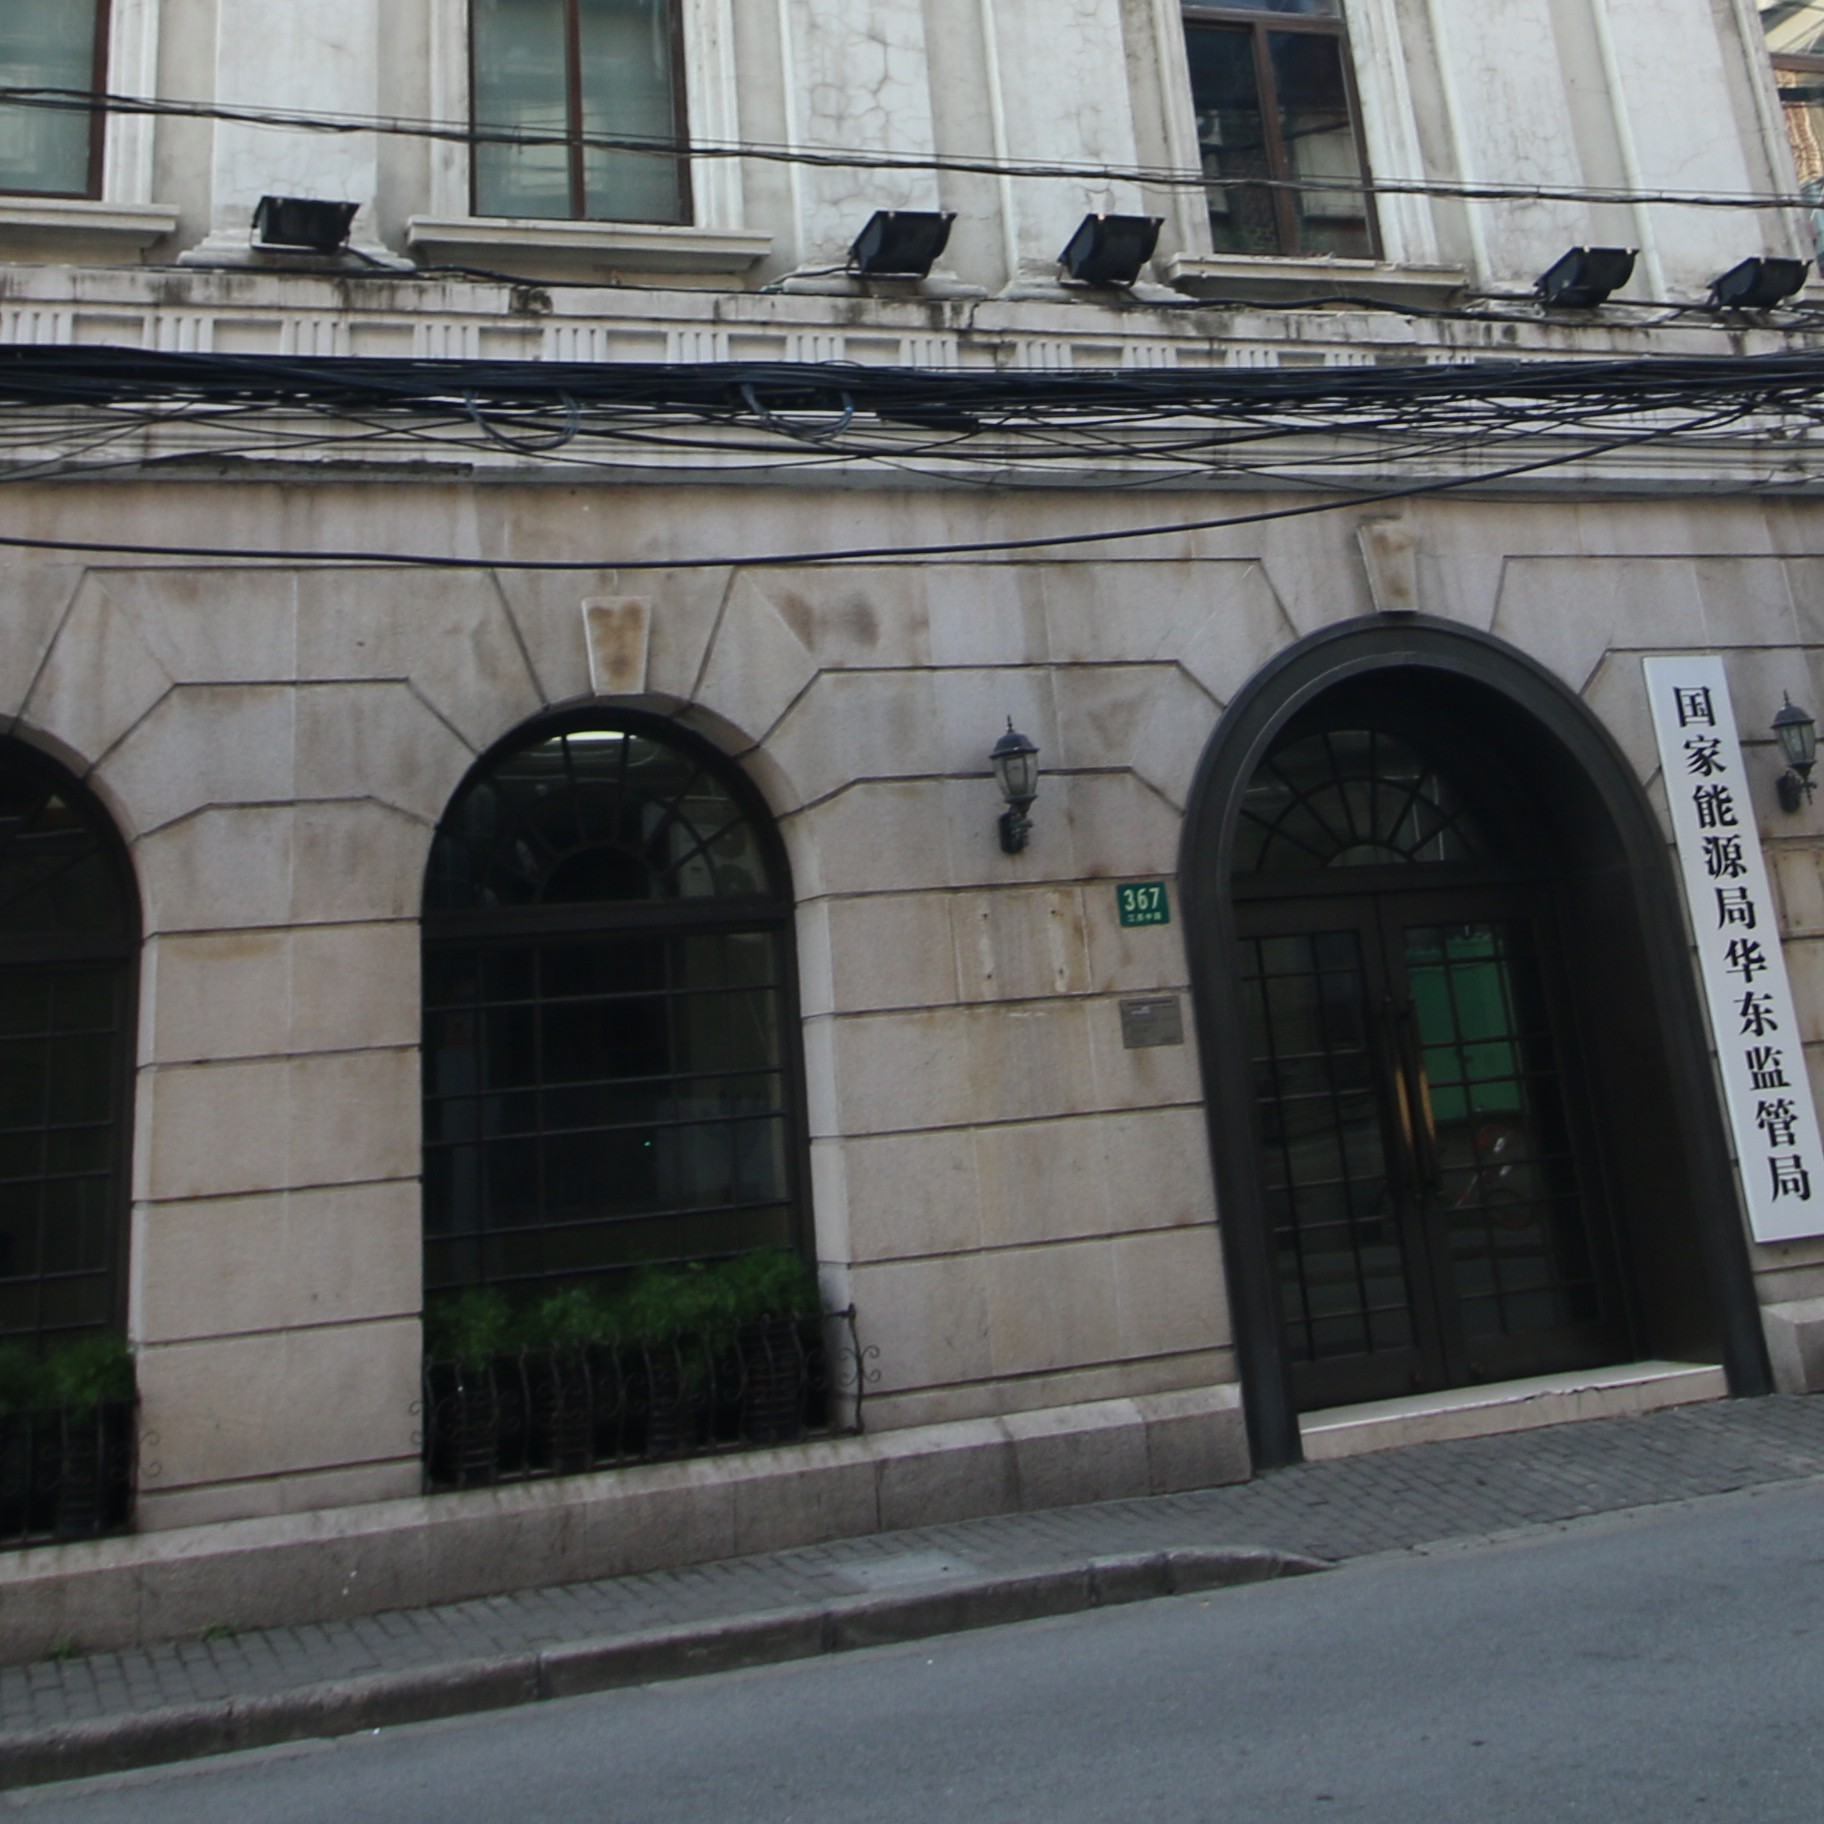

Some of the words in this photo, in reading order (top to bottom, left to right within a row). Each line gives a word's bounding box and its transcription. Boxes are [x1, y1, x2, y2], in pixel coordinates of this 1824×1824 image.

[1123, 887, 1160, 911] 367
[1673, 685, 1811, 1203] 国家能源局华东监管局
